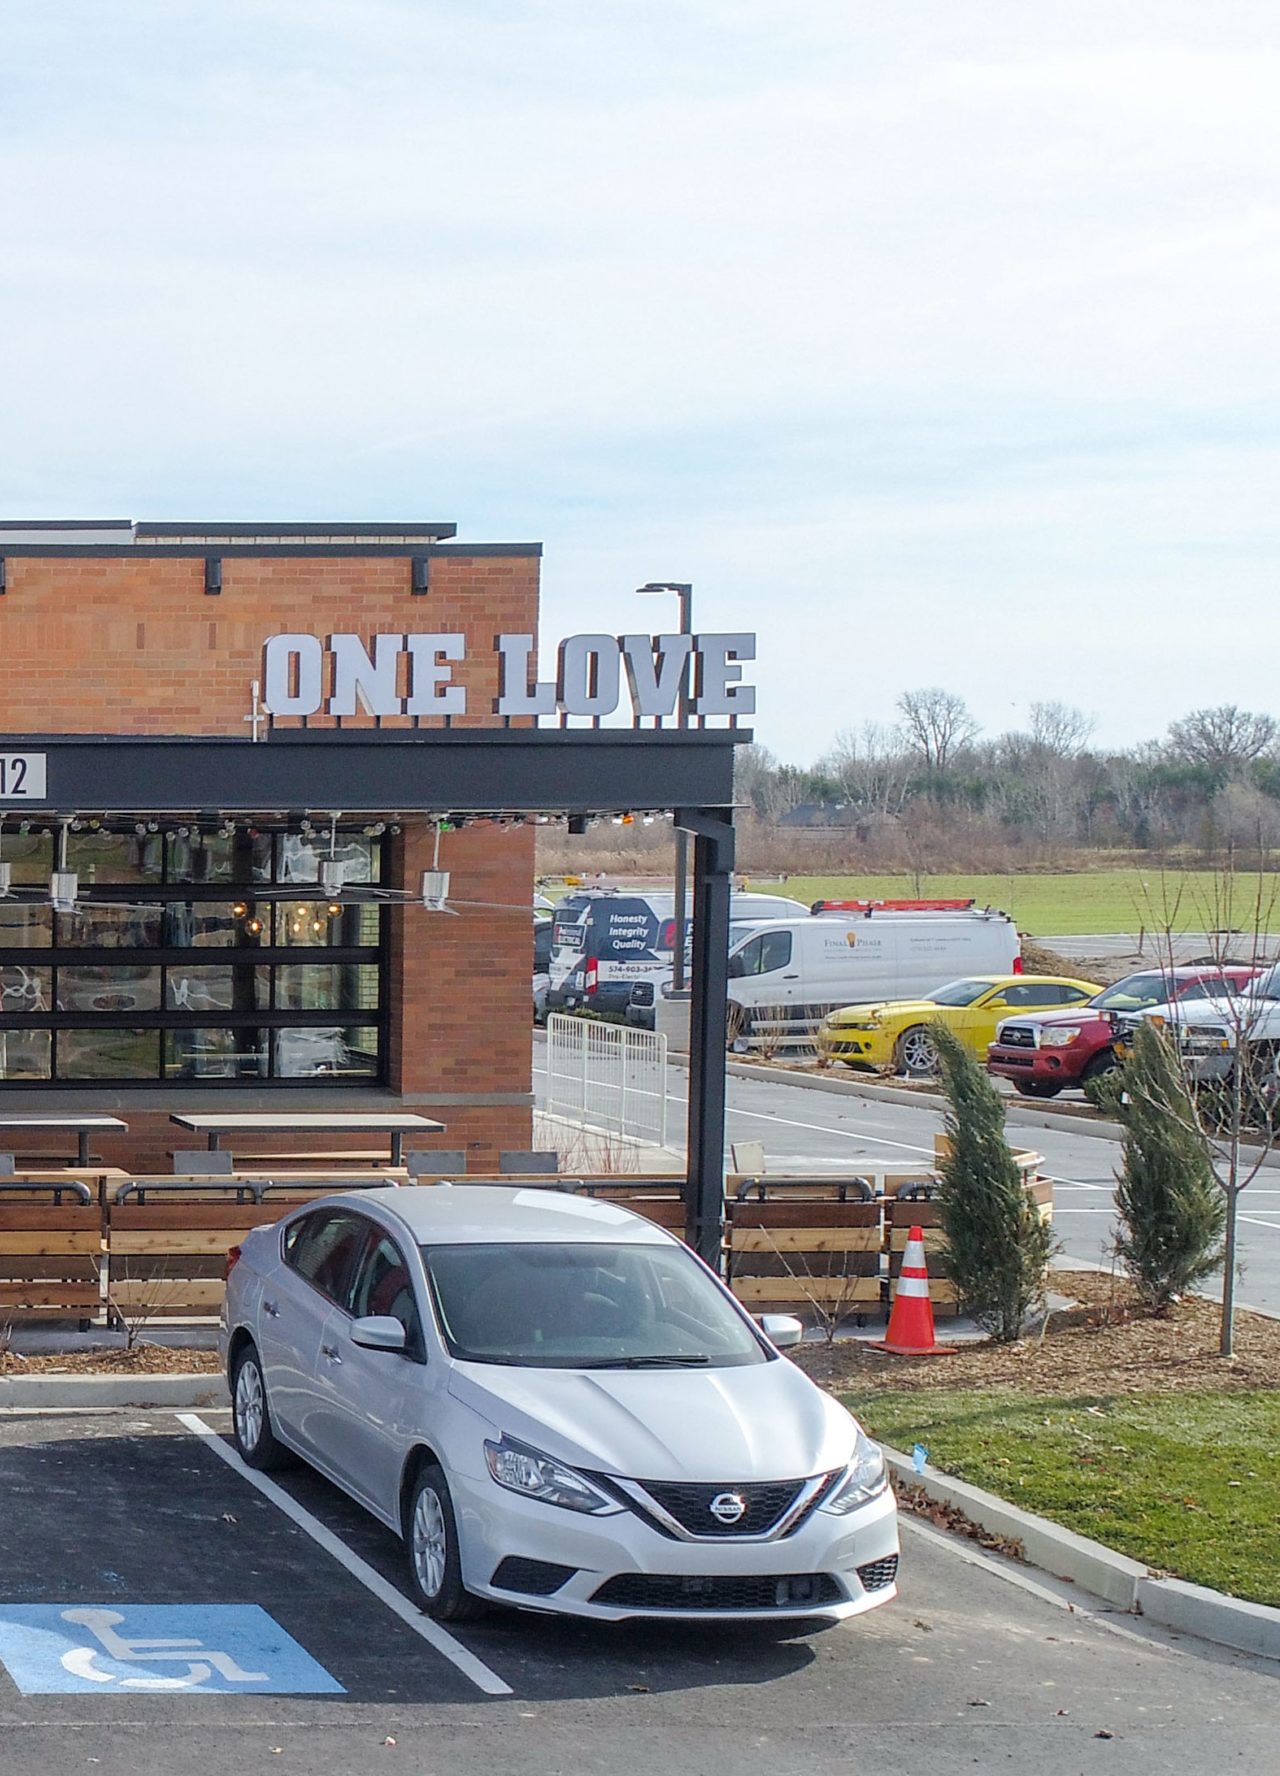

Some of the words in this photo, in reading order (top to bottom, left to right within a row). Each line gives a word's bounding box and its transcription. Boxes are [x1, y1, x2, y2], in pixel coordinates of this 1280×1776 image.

[263, 633, 467, 717] ONE
[493, 632, 757, 716] LOVE
[610, 914, 648, 925] Honesty
[609, 927, 650, 938] Integrity
[612, 939, 647, 951] Quality
